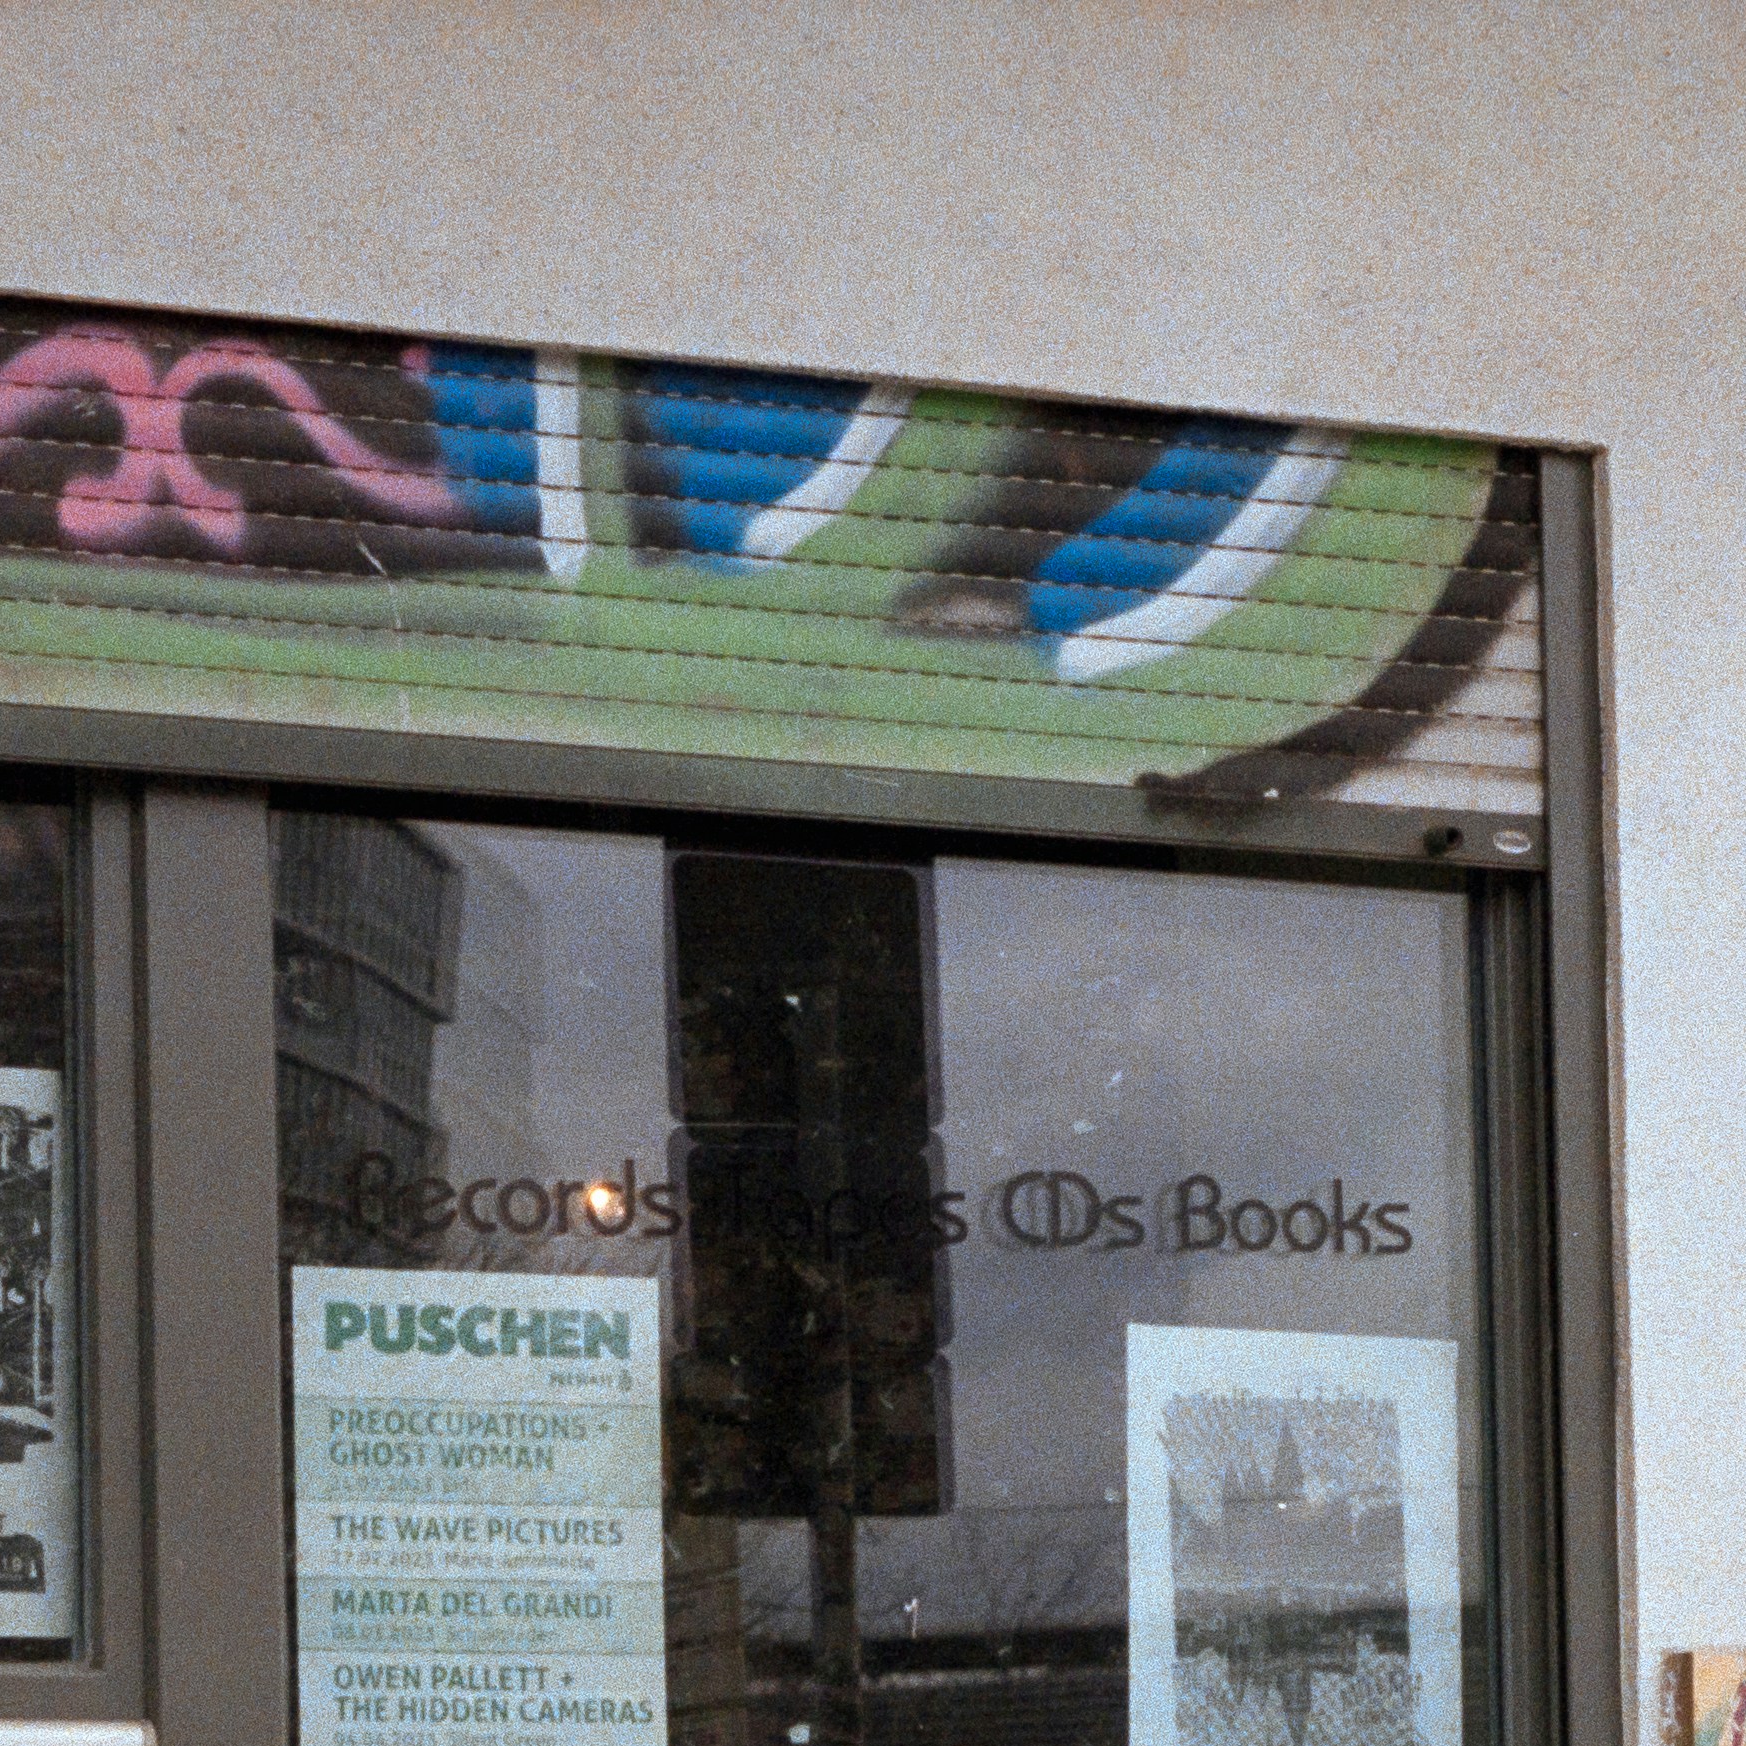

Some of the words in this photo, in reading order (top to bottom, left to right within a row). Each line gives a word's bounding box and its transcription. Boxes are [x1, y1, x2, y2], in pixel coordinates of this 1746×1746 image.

[344, 1150, 682, 1240] Records
[1172, 1172, 1414, 1257] Books
[323, 1300, 631, 1360] PUSCHEN
[328, 1408, 588, 1441] PREOCCUPATIONS
[328, 1440, 426, 1468] GHOST
[439, 1444, 555, 1471] WOMAN
[329, 1514, 385, 1541] THE
[394, 1516, 478, 1543] WAVE
[487, 1518, 624, 1547] PICTURES
[332, 1589, 432, 1617] MARTA
[441, 1591, 493, 1618] DEL
[502, 1592, 612, 1621] GRANDI
[332, 1664, 423, 1691] OWEN
[430, 1665, 549, 1692] PALLETT
[333, 1696, 390, 1723] THE
[397, 1697, 510, 1724] HIDDEN
[517, 1698, 654, 1726] CAMERAS
